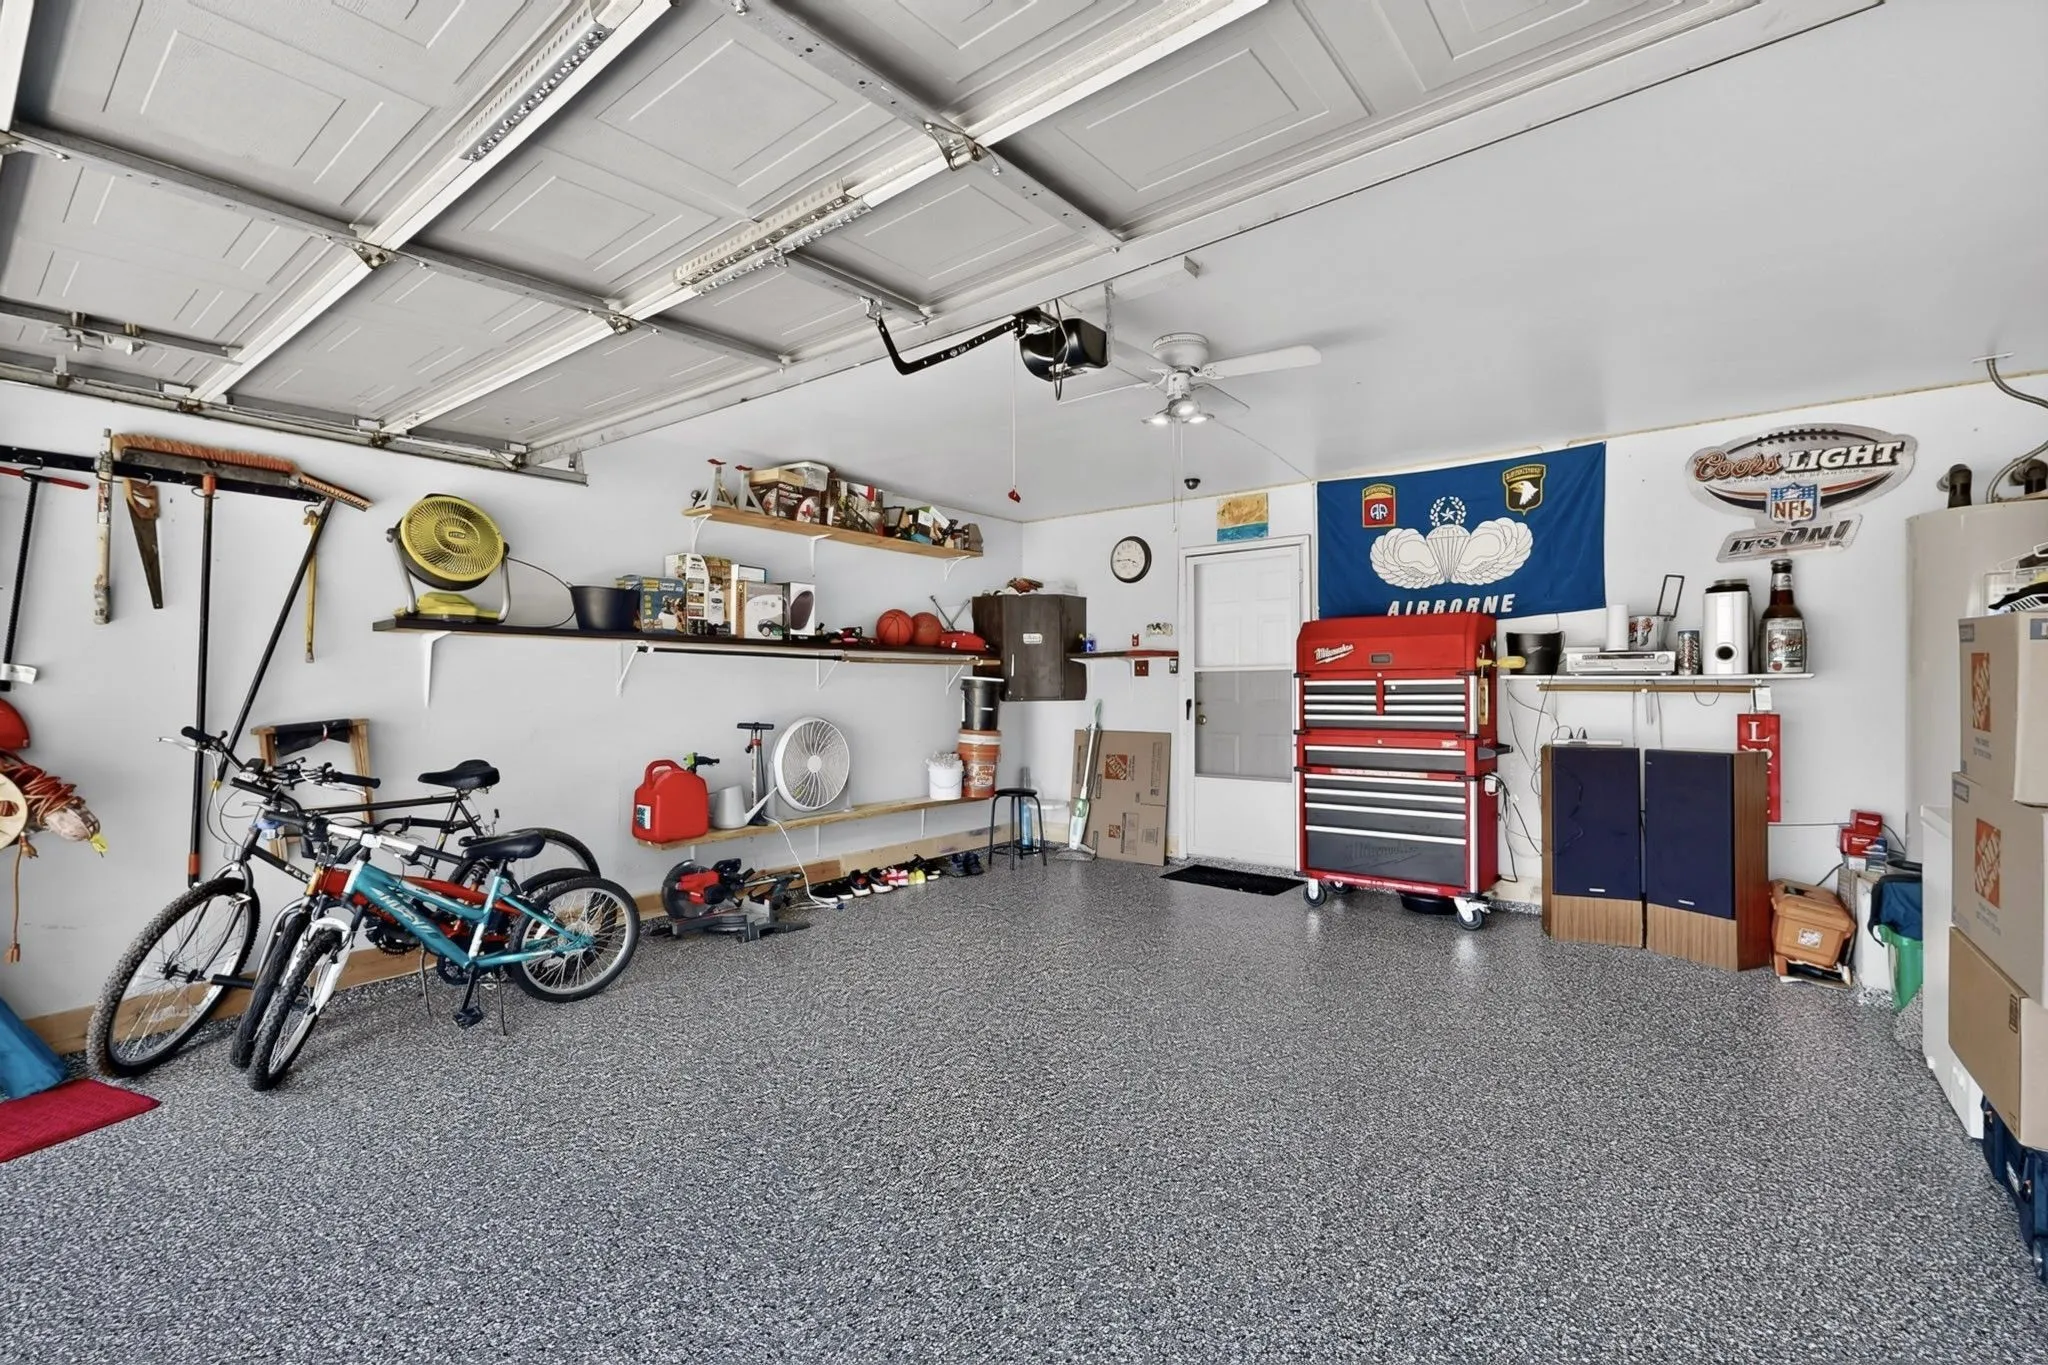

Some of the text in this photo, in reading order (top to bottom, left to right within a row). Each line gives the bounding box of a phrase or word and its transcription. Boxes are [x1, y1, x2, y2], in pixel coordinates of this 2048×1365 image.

[1695, 442, 1905, 481] Coors LIGHT
[1774, 500, 1812, 519] NFL
[1729, 519, 1853, 553] IT'S ON!
[1387, 594, 1516, 617] AIRBORNE
